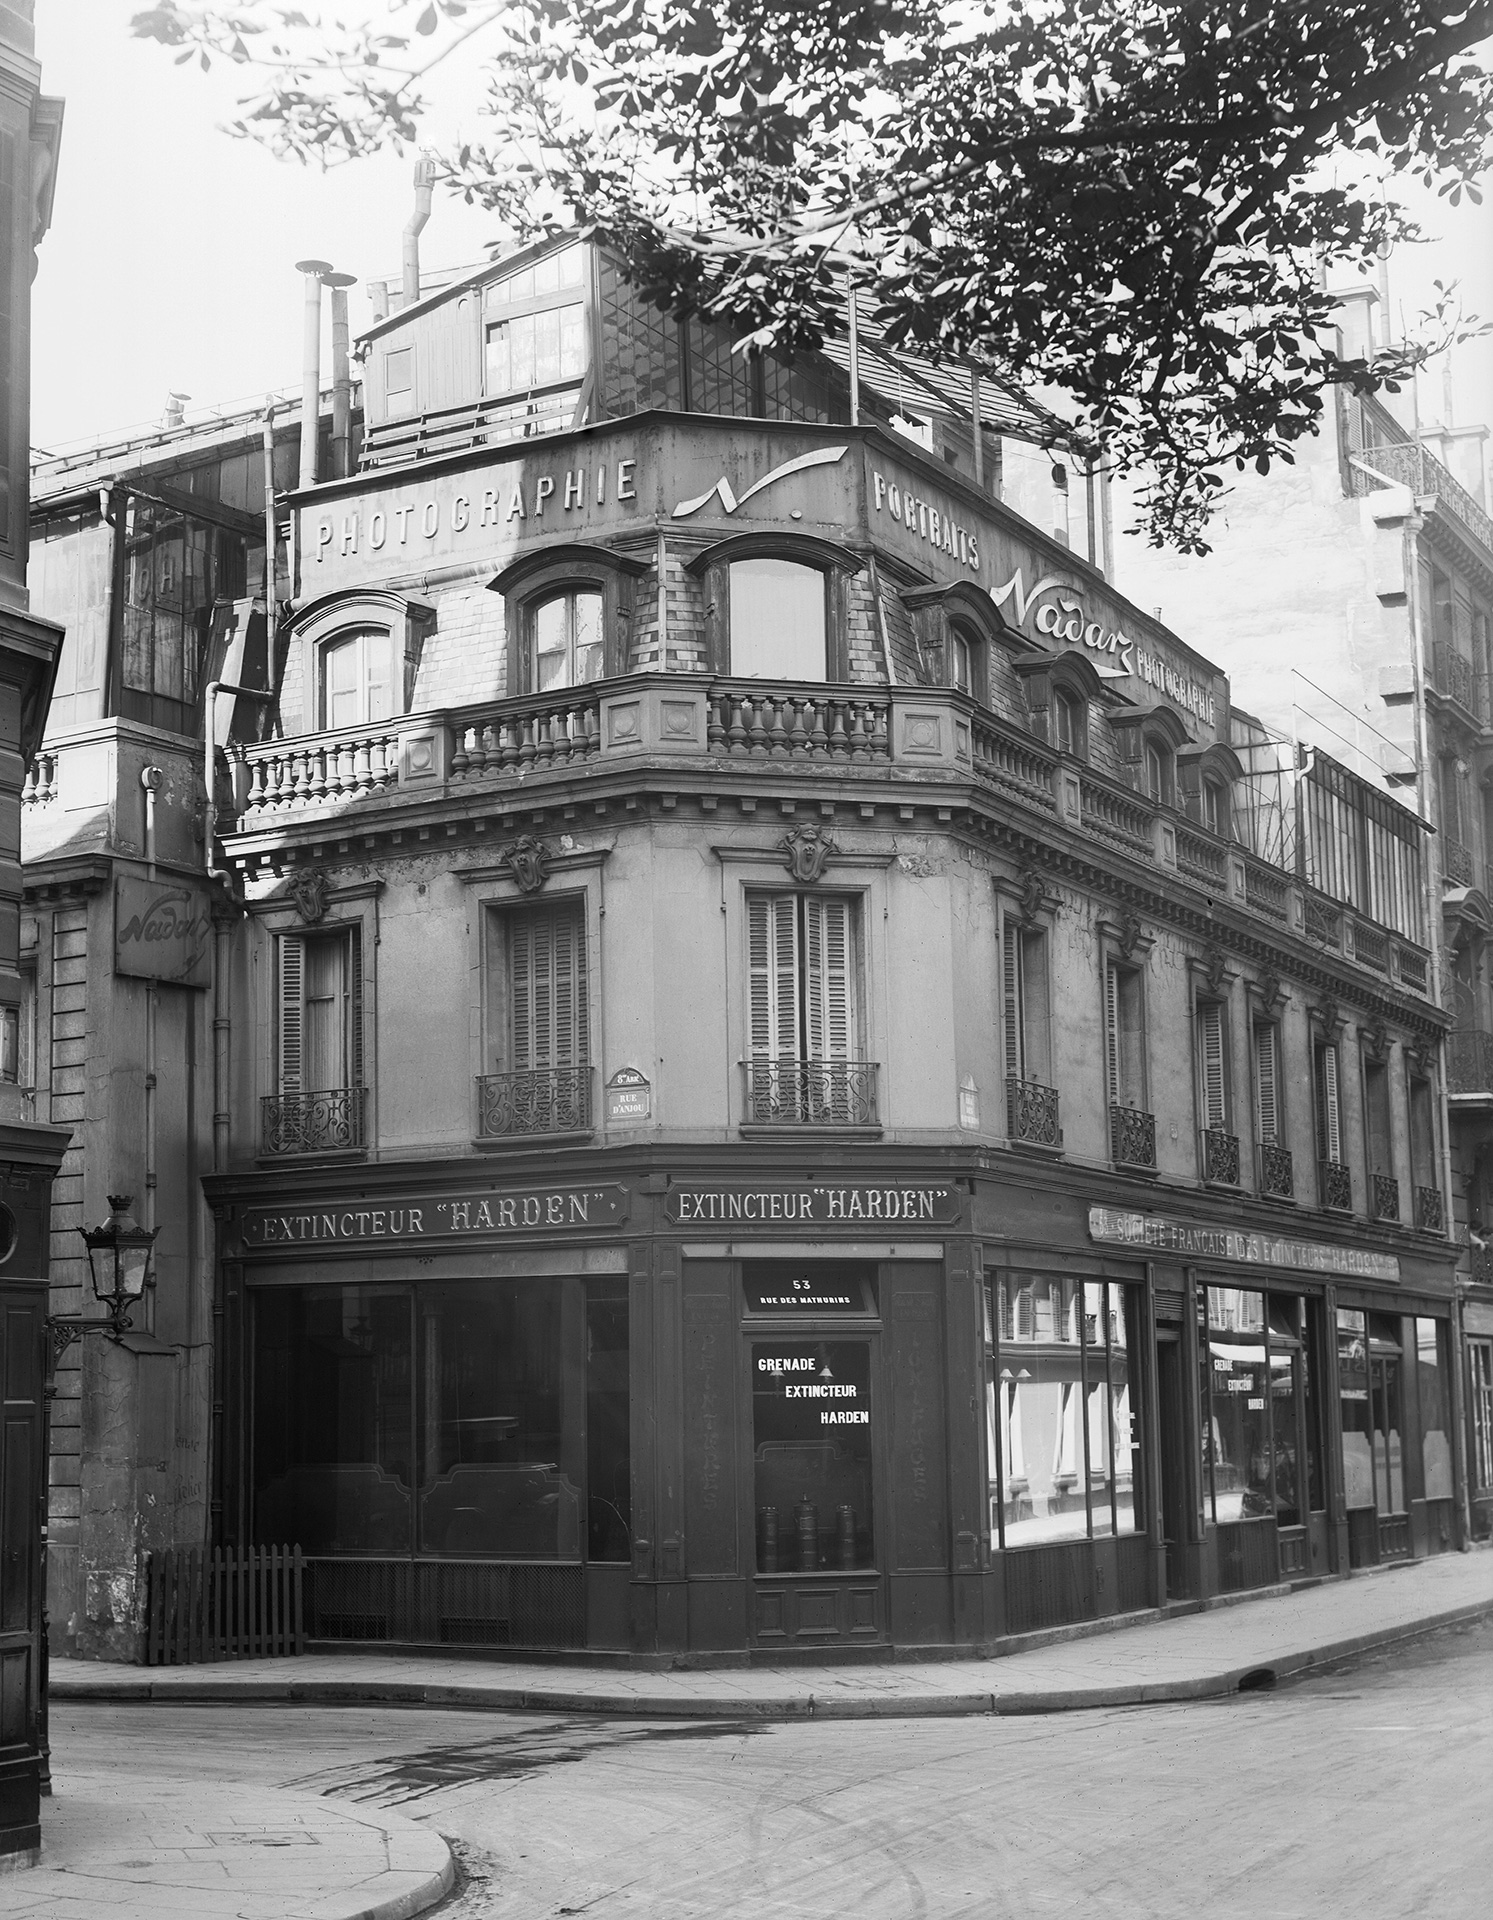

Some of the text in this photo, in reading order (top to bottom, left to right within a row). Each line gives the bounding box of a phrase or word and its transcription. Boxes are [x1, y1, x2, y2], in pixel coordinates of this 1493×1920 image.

[316, 458, 638, 563] PHOTOGRAPHIE
[873, 471, 980, 571] PORTRAITS
[989, 567, 1135, 678] Nadar
[1137, 647, 1215, 729] PHOTOGRAPHIE
[118, 890, 212, 970] Nadar
[613, 1104, 644, 1114] D'ANJOU
[620, 1094, 637, 1103] RUE
[679, 1193, 814, 1219] EXTINCTEUR
[263, 1208, 425, 1241] EXTINCTEUR
[1239, 1236, 1258, 1261] DES
[1263, 1242, 1325, 1270] EXTINCTEURS
[792, 1280, 811, 1290] 53
[758, 1358, 816, 1371] GRENADE
[785, 1384, 857, 1398] EXTINCTEUR
[820, 1411, 869, 1424] HARDEN
